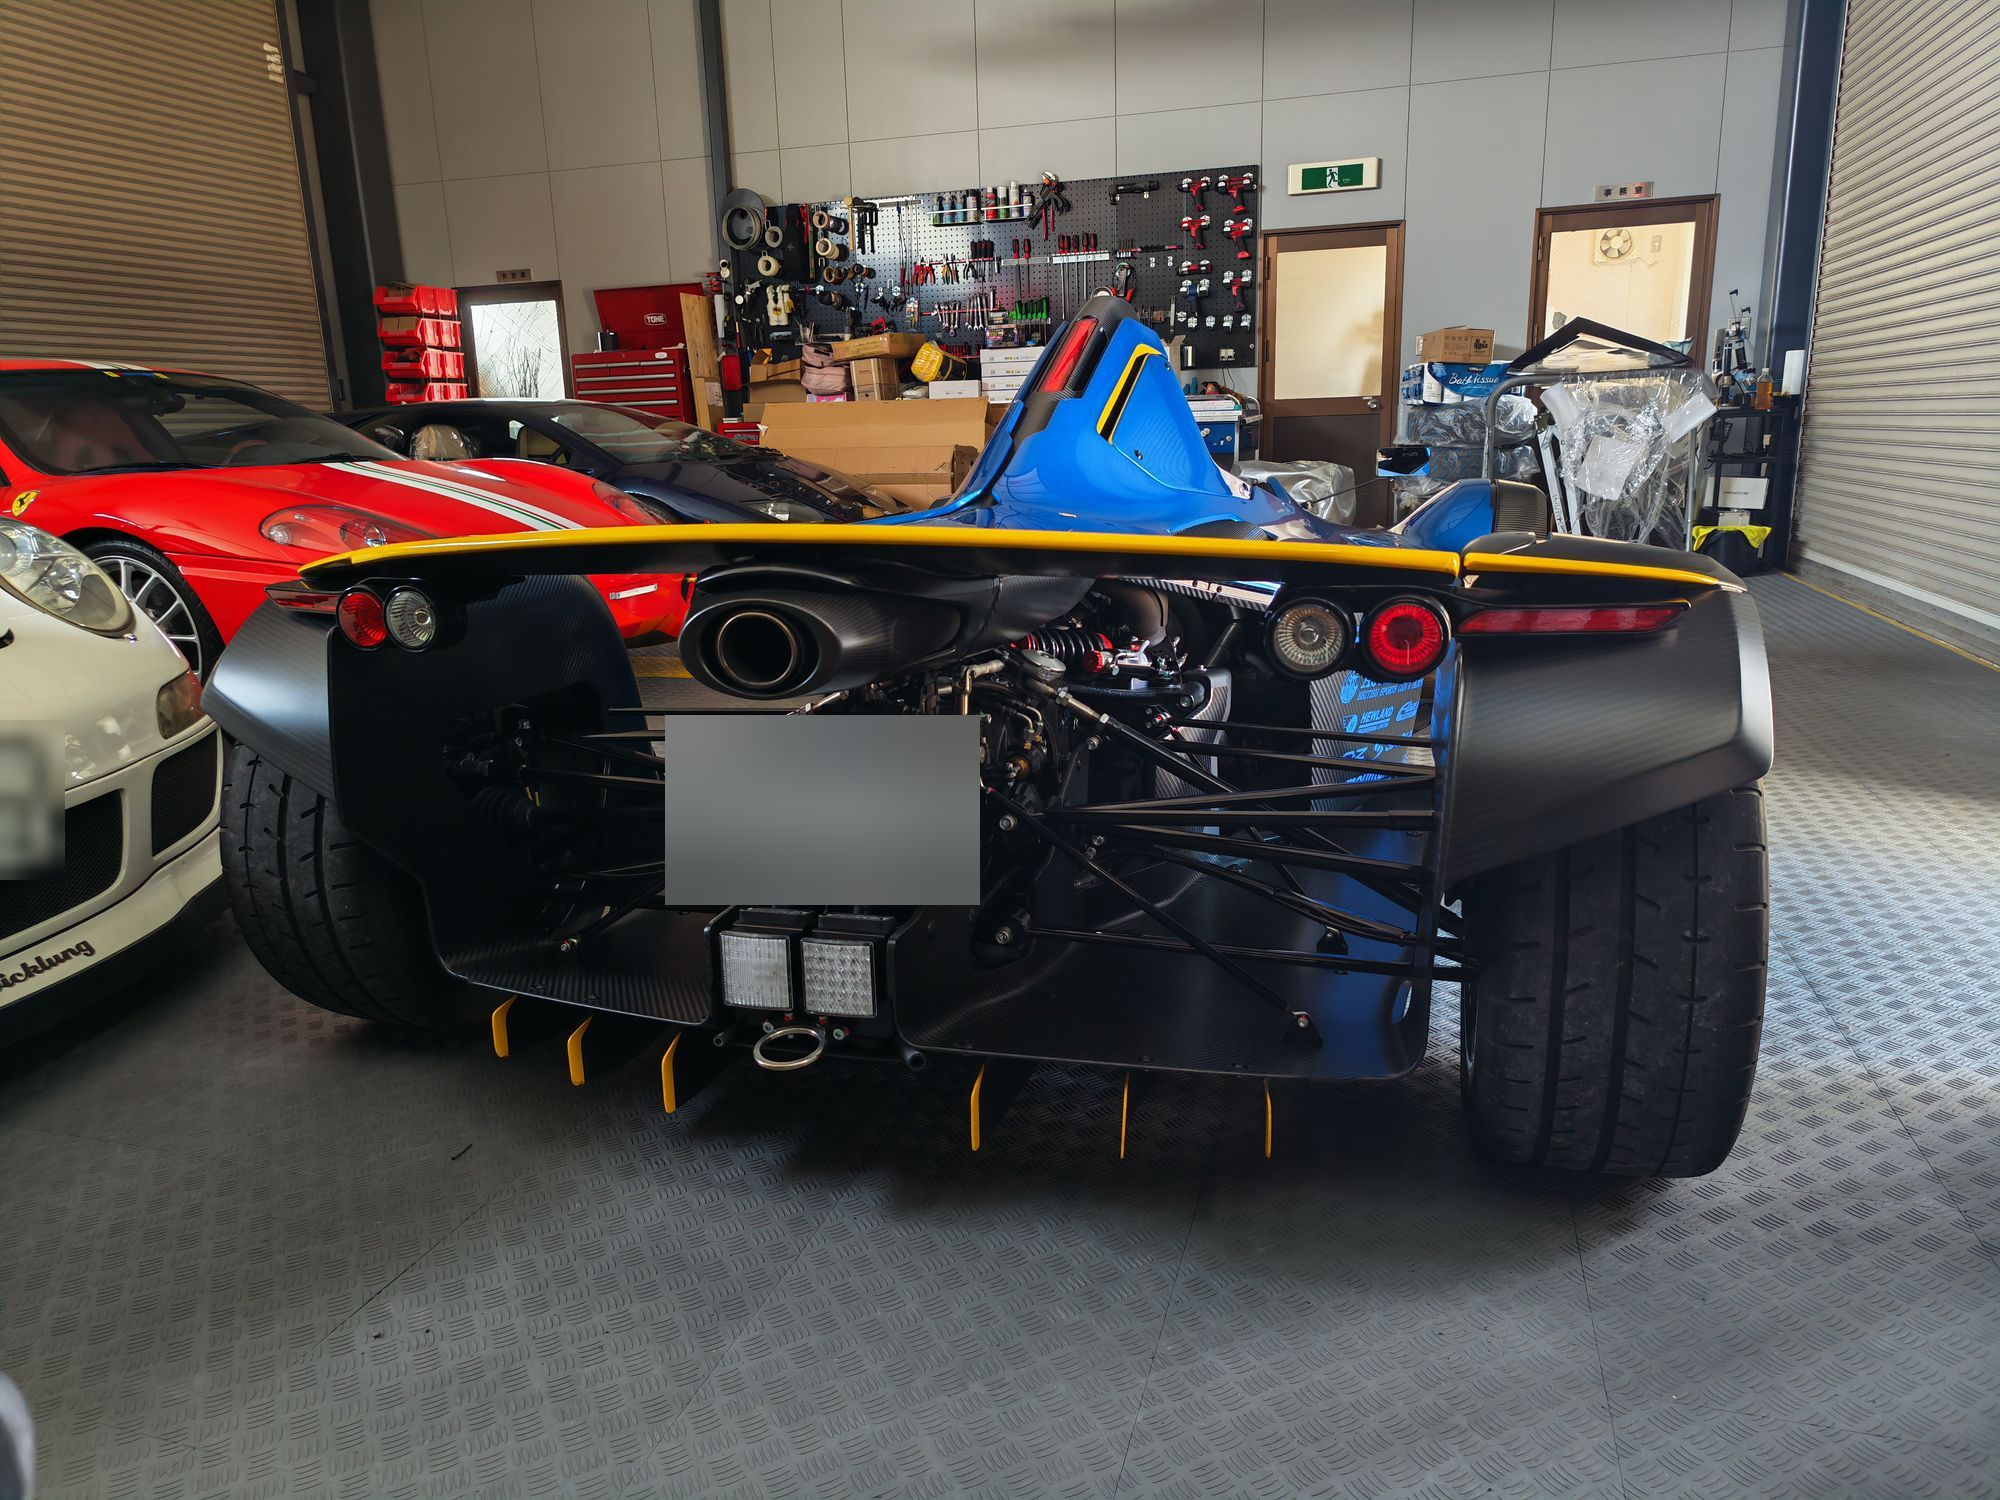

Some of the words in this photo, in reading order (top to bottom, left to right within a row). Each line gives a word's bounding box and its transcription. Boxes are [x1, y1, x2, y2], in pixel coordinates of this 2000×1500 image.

[1604, 186, 1643, 197] 事務室
[646, 315, 665, 324] TONE
[1449, 372, 1473, 386] Bath
[1474, 373, 1500, 384] Tissue
[1361, 706, 1394, 723] HEWLAND
